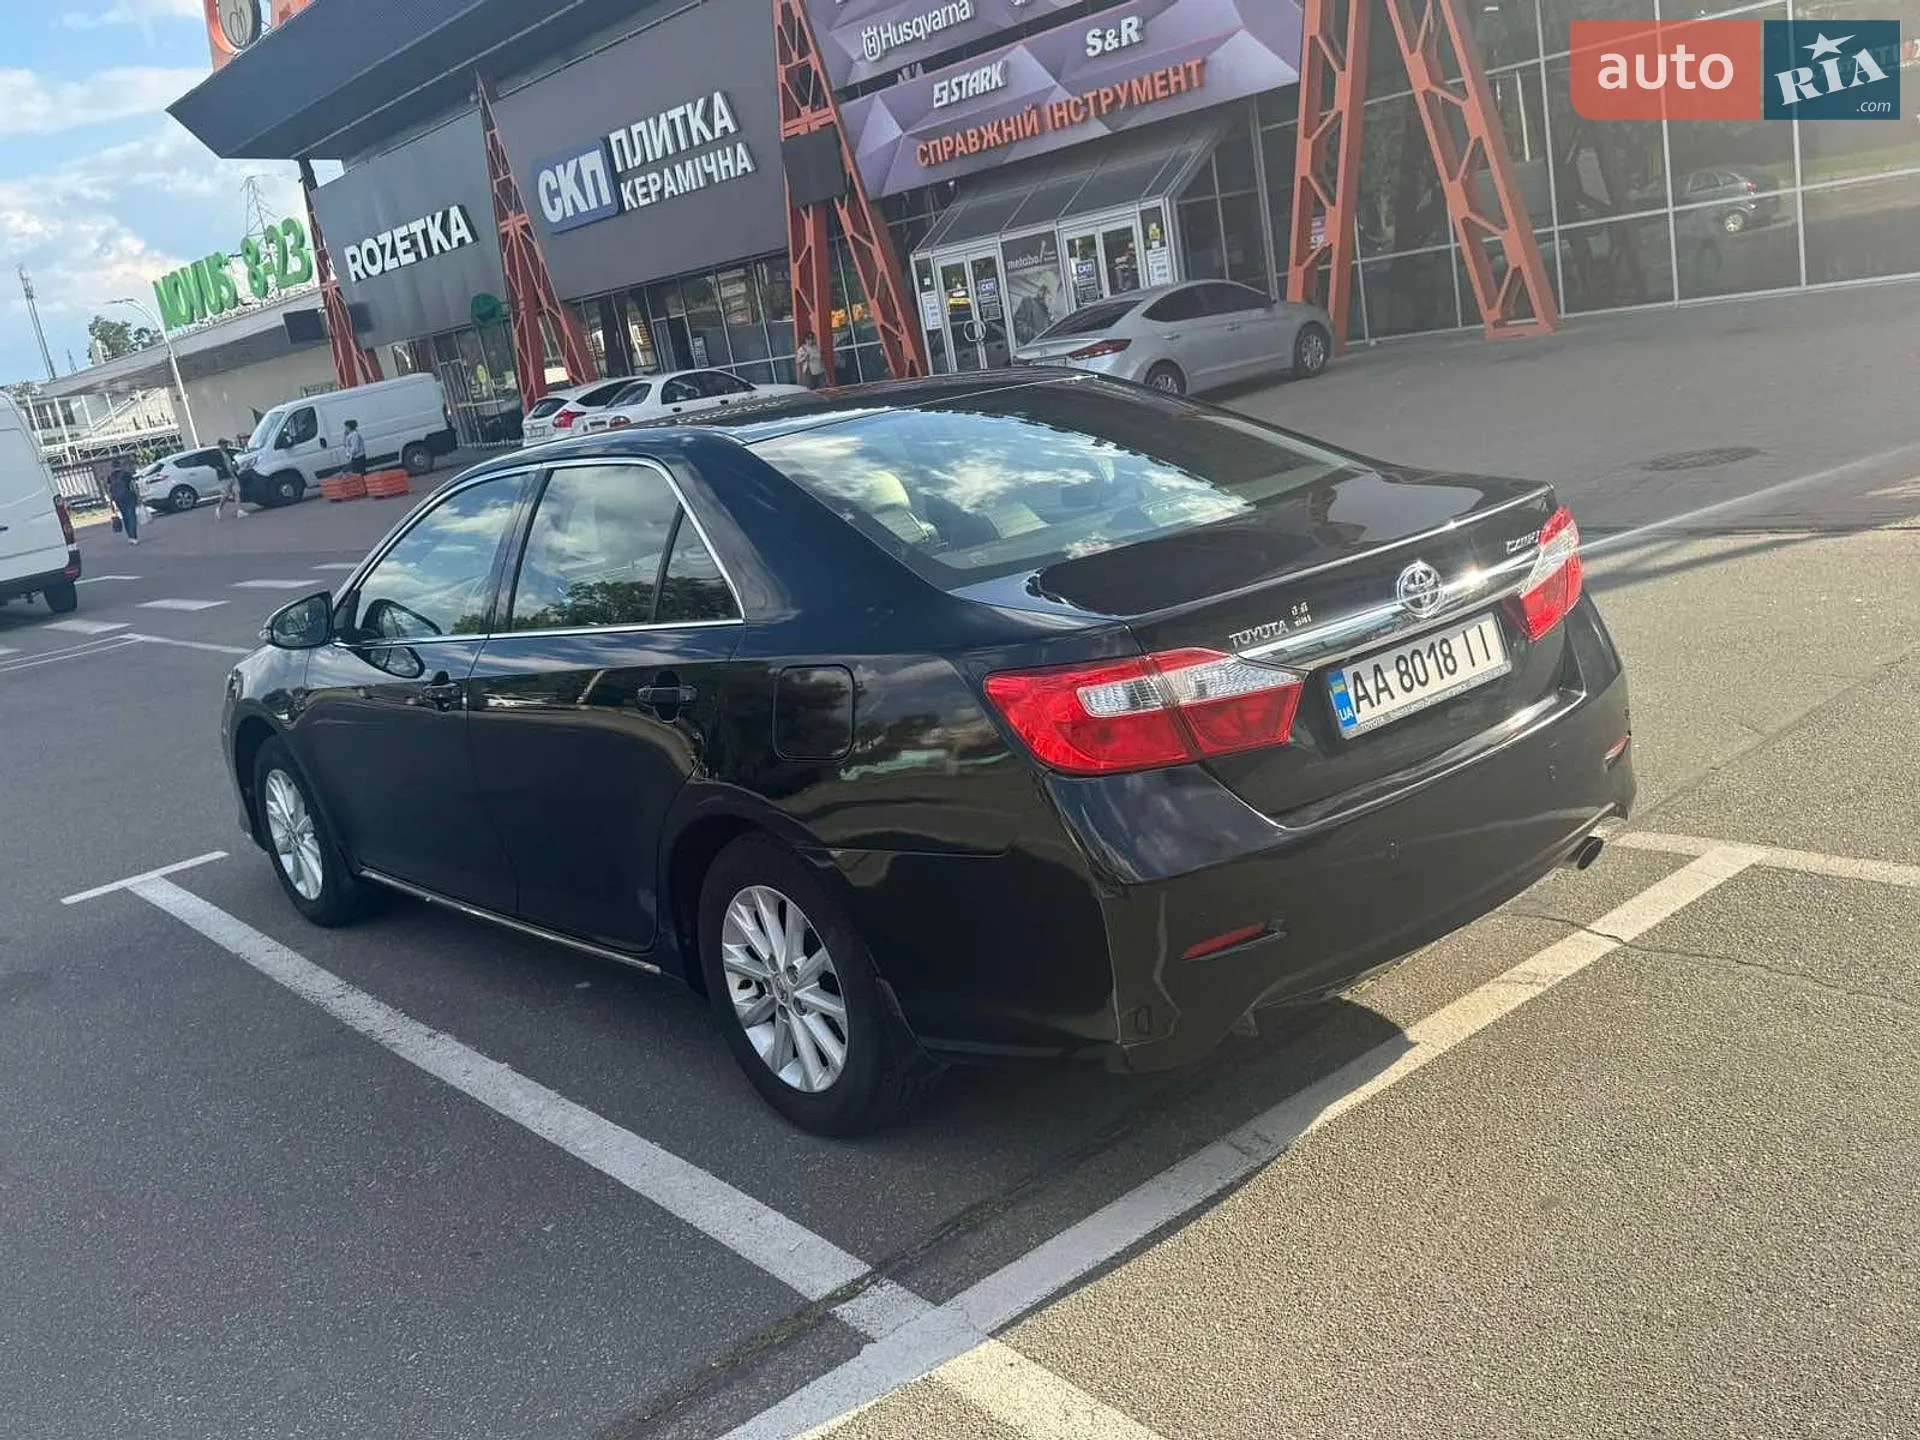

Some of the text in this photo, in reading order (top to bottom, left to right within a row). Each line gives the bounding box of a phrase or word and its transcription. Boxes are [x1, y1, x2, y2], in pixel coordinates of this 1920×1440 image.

[879, 0, 974, 51] Husqvarna
[1085, 15, 1144, 57] S&R
[608, 90, 739, 174] ПЛИТКА
[915, 57, 1208, 169] СПРАВЖНІЙ ІНСТРУМЕНТ
[537, 149, 613, 224] СКП
[619, 141, 757, 212] КЕРАМІЧНА
[240, 215, 314, 300] 8-23
[343, 204, 477, 283] ROZETKA
[1228, 619, 1289, 649] TOYOTA
[1352, 663, 1396, 714] AA
[1395, 637, 1458, 694] 8018
[1462, 624, 1491, 668] II
[1338, 707, 1355, 721] UA
